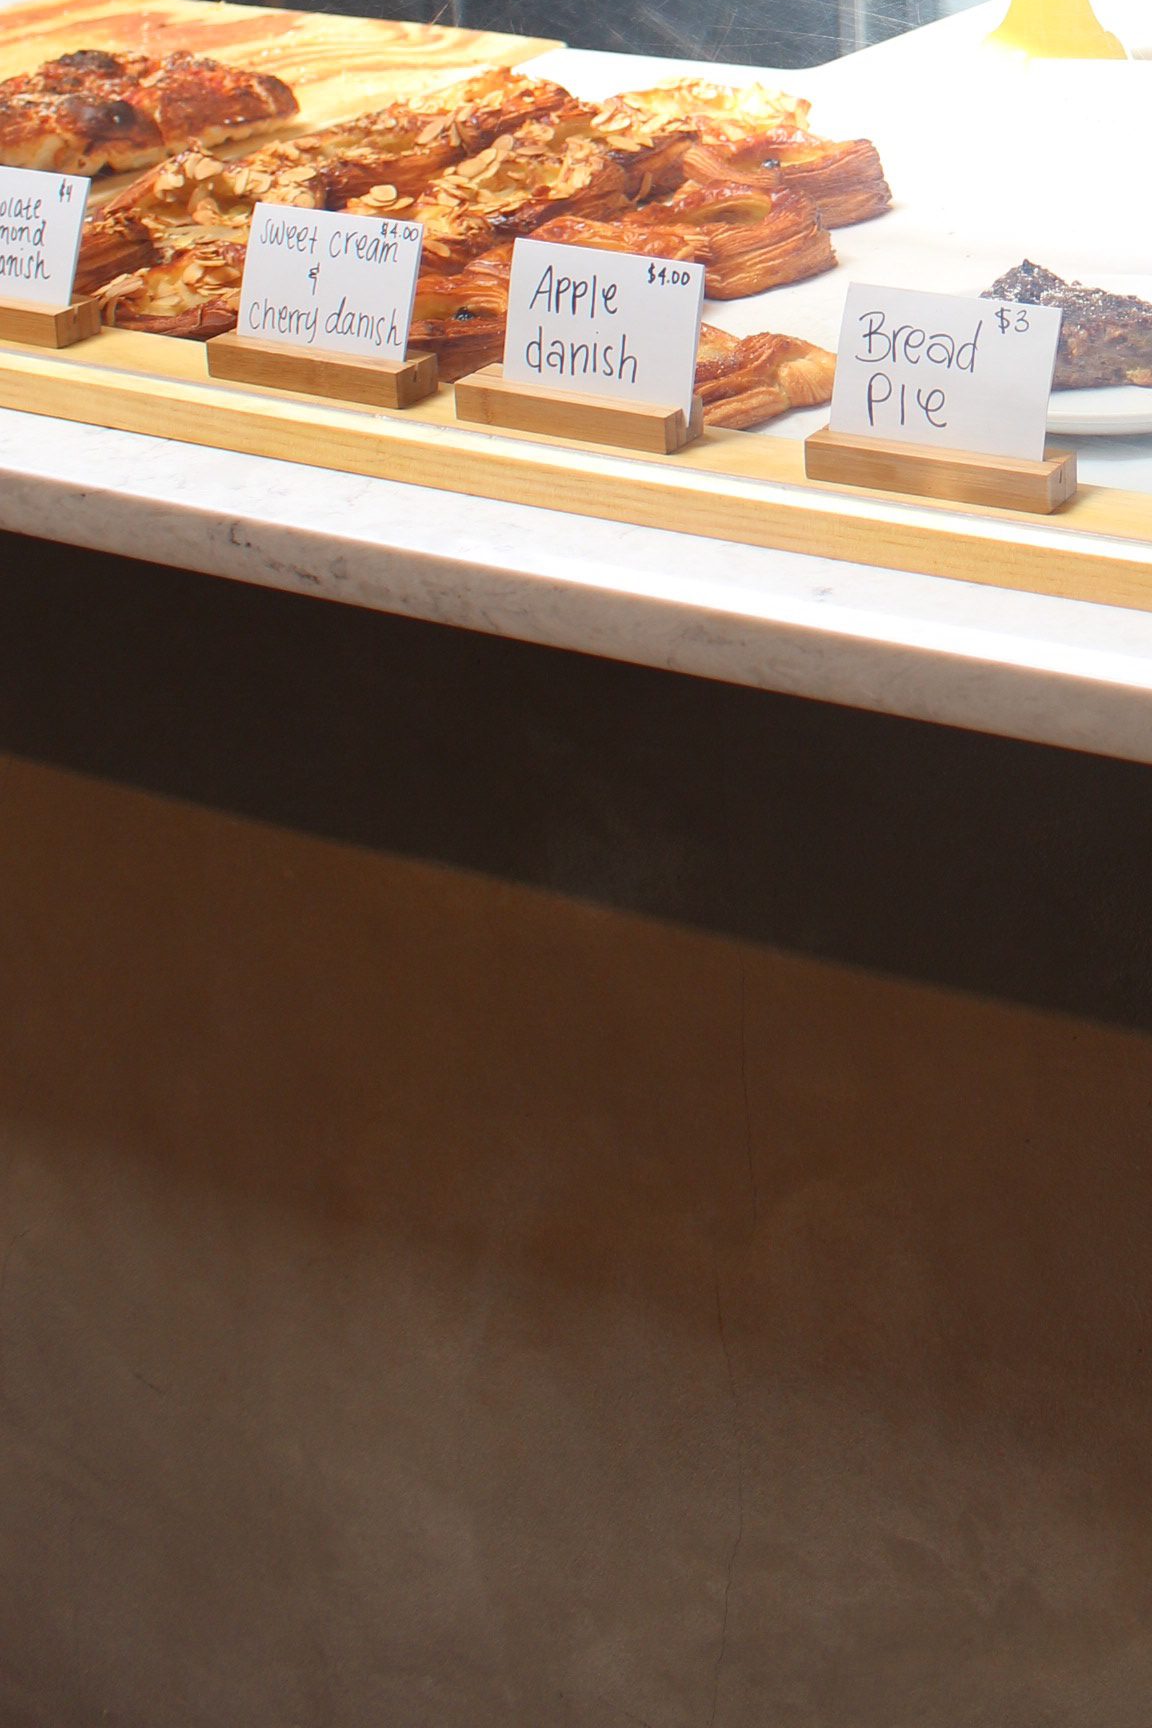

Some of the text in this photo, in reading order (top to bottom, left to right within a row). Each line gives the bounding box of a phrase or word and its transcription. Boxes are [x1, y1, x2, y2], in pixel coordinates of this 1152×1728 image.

[329, 229, 399, 264] cream
[380, 222, 420, 243] $4.00
[529, 265, 618, 319] Apple
[648, 263, 691, 286] $4.00
[325, 296, 402, 348] danish
[855, 307, 1030, 373] Bread $3
[525, 325, 638, 384] danish
